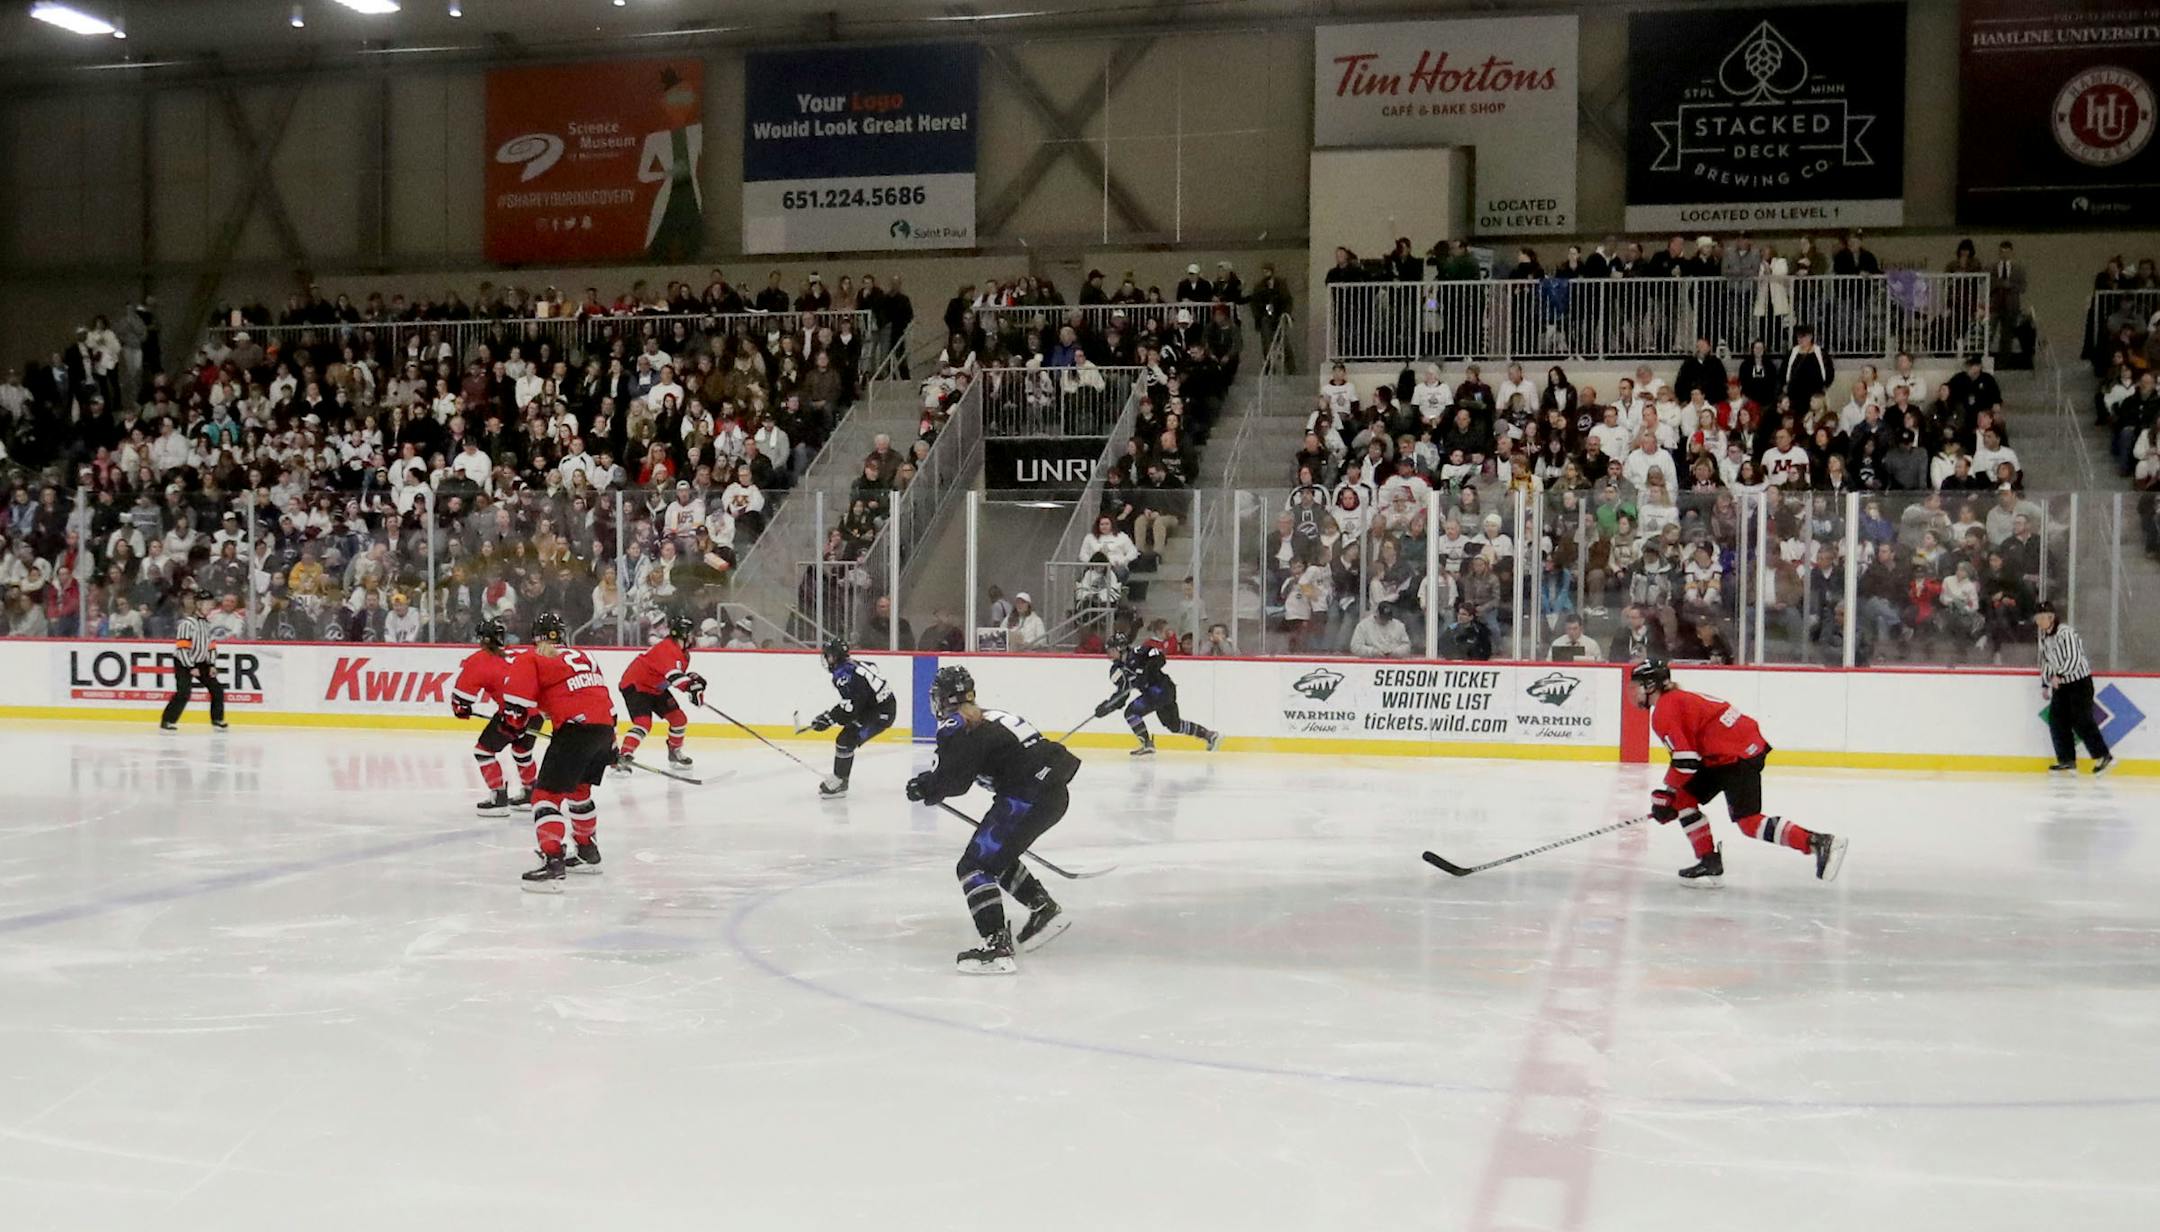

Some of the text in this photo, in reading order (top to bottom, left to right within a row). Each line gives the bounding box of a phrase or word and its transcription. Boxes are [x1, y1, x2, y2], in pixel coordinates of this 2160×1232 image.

[1972, 25, 2160, 46] HAMLINE UNIVERSITY
[1333, 50, 1557, 97] Tim Hortons
[797, 92, 904, 113] Your Logo
[1382, 101, 1506, 117] CAFÉ & BAKE SHOP
[1695, 113, 1831, 137] STACKED
[2083, 94, 2129, 140] HU
[568, 121, 620, 135] Science
[754, 112, 967, 139] Would Look Great Here!
[580, 135, 636, 149] Museum
[1734, 144, 1790, 159] DECK
[1694, 162, 1790, 188] BREWING
[782, 186, 926, 209] 651.224.5686
[1489, 199, 1557, 212] LOCATED
[1480, 214, 1566, 228] ON LEVEL 2
[1681, 206, 1840, 222] LOCATED ON LEVEL 1
[913, 226, 968, 239] Saint Paul
[1373, 669, 1500, 689] SEASON TICKET
[1381, 690, 1493, 711] WAITING LIST
[1283, 710, 1356, 721] WARMING
[1363, 712, 1508, 733] tickets.wild.com
[1516, 714, 1592, 727] WARMING
[1301, 721, 1337, 733] House
[1535, 726, 1573, 738] House
